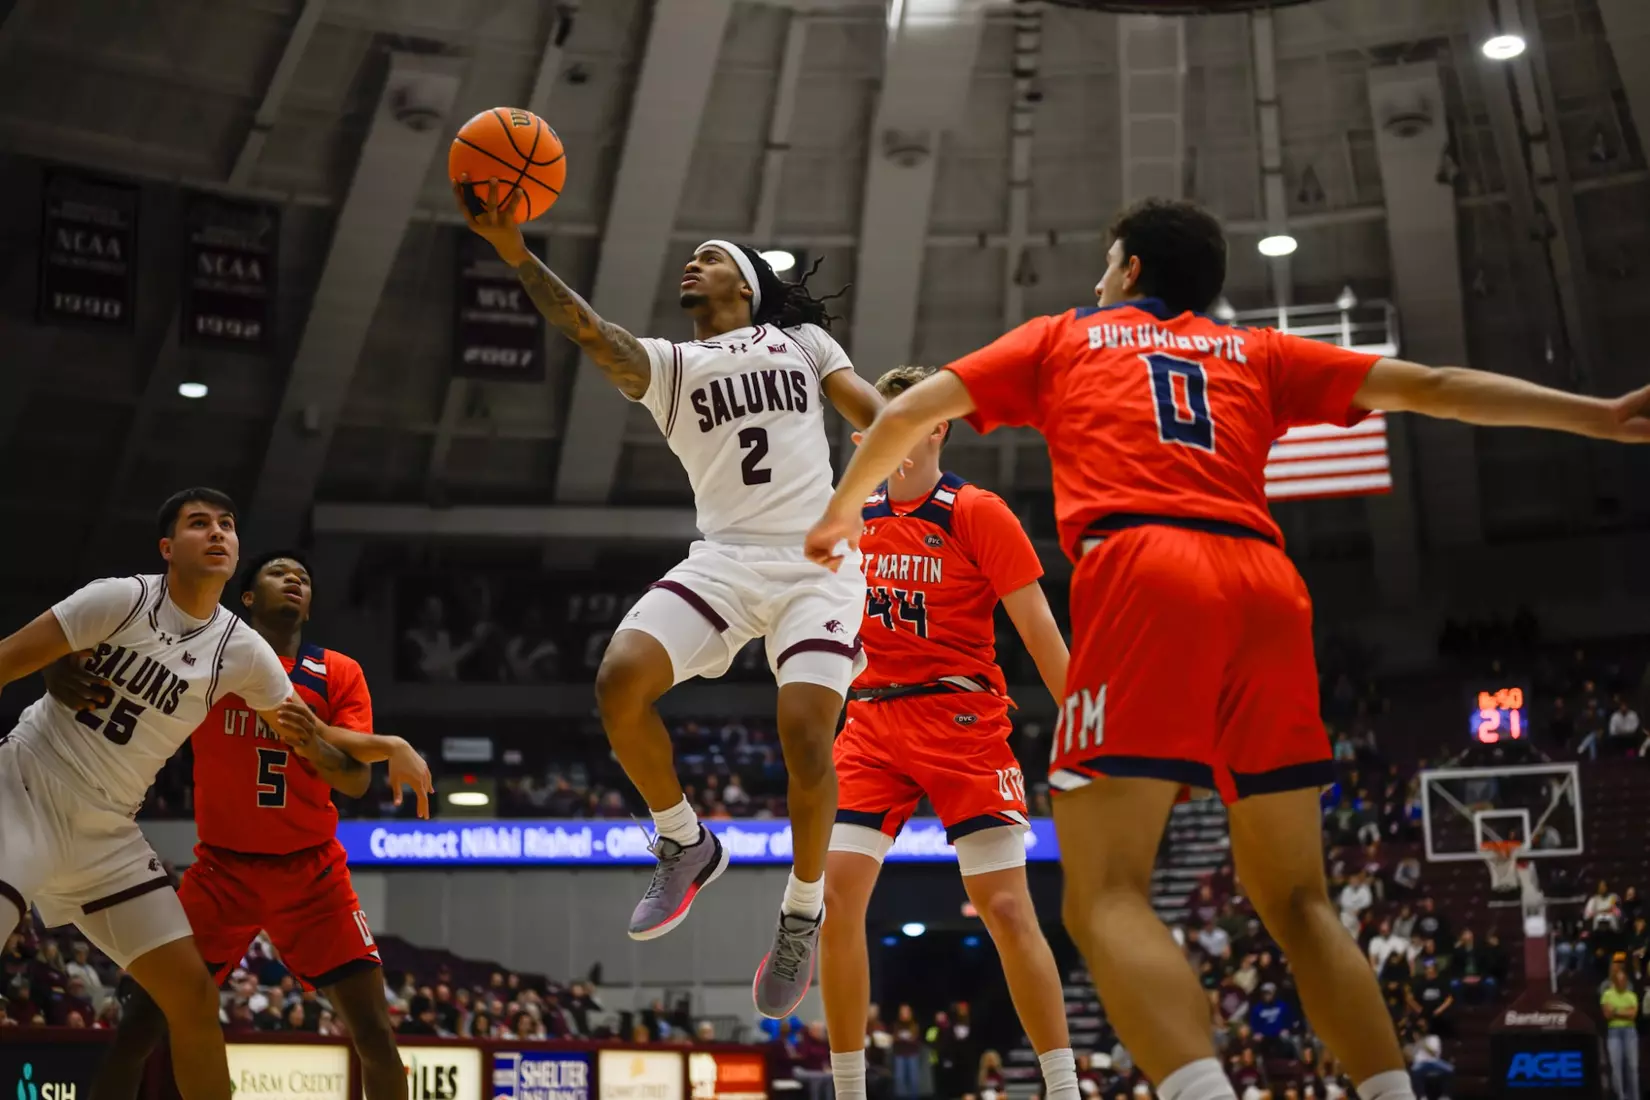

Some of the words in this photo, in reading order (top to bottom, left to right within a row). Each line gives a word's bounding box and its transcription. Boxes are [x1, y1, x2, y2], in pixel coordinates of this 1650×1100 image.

[56, 227, 121, 260] NCAA
[199, 252, 262, 281] NCAA
[54, 292, 122, 320] 1990
[690, 369, 808, 433] SALUKIS
[1138, 351, 1216, 454] 0
[738, 427, 772, 486] 2
[874, 553, 943, 584] MARTIN
[866, 586, 929, 639] 44
[84, 643, 189, 715] SALUKIS
[75, 683, 147, 746] 25
[224, 709, 249, 737] UT
[1478, 709, 1520, 743] 21
[256, 747, 289, 809] 5
[370, 828, 458, 858] Contact
[240, 1069, 283, 1093] FARM
[288, 1070, 345, 1094] CREDIT
[520, 1060, 588, 1088] SHELTER
[1507, 1052, 1583, 1080] AGE
[41, 1082, 76, 1100] SIH
